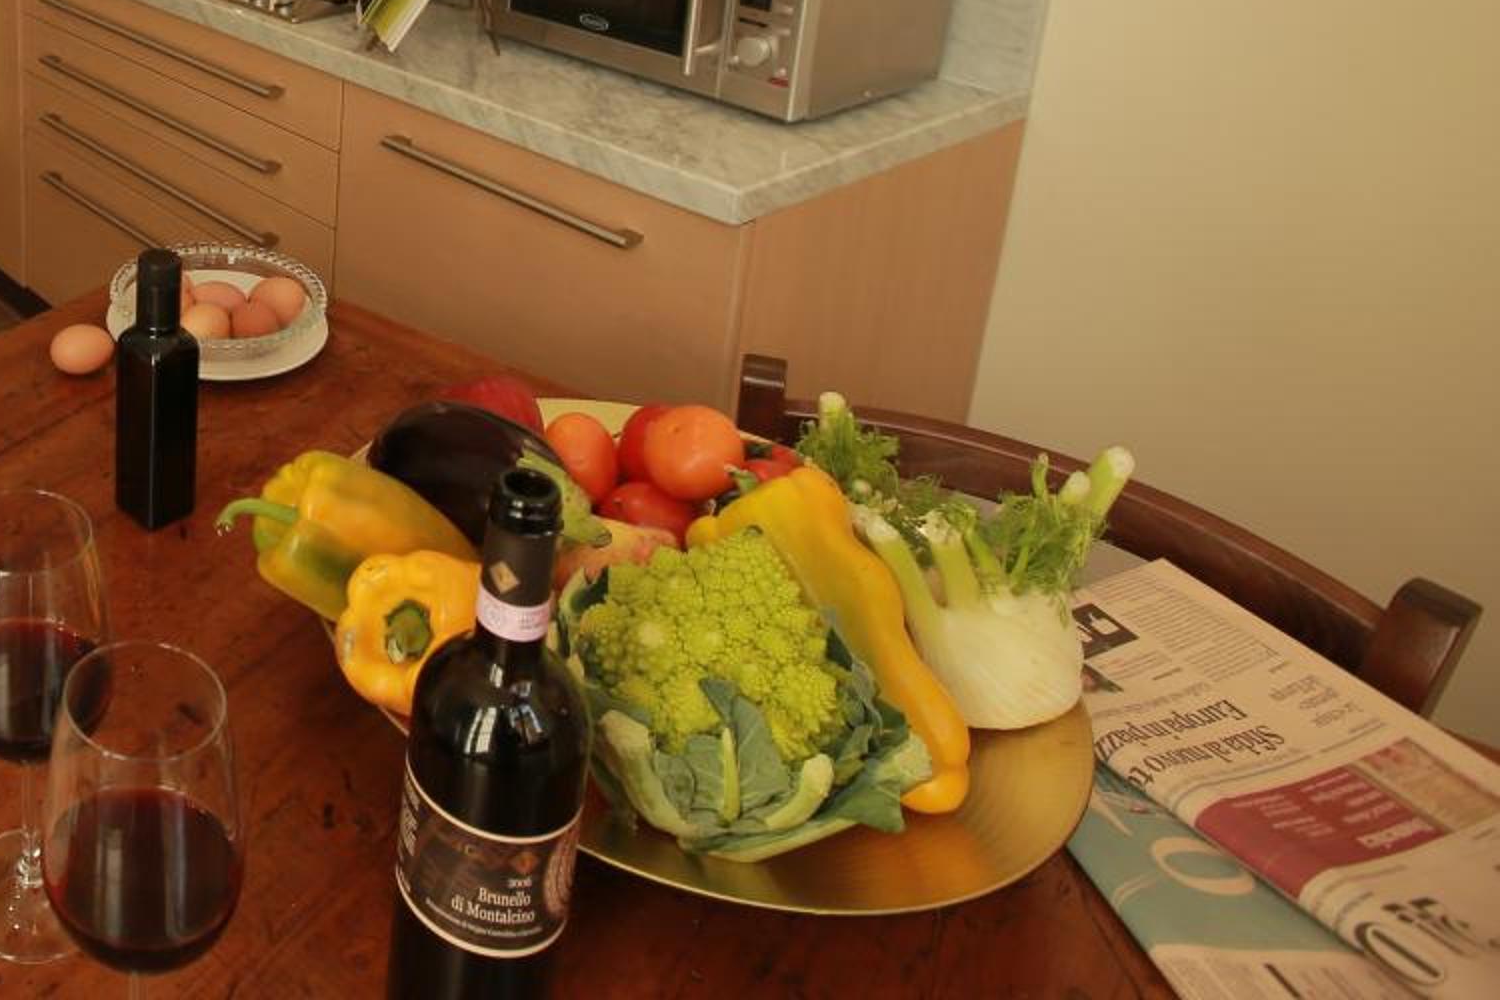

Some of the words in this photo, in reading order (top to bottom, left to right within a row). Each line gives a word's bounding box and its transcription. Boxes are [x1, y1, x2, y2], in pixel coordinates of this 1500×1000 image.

[451, 893, 464, 913] di
[465, 900, 536, 925] Montalcino
[478, 886, 532, 907] Brunello
